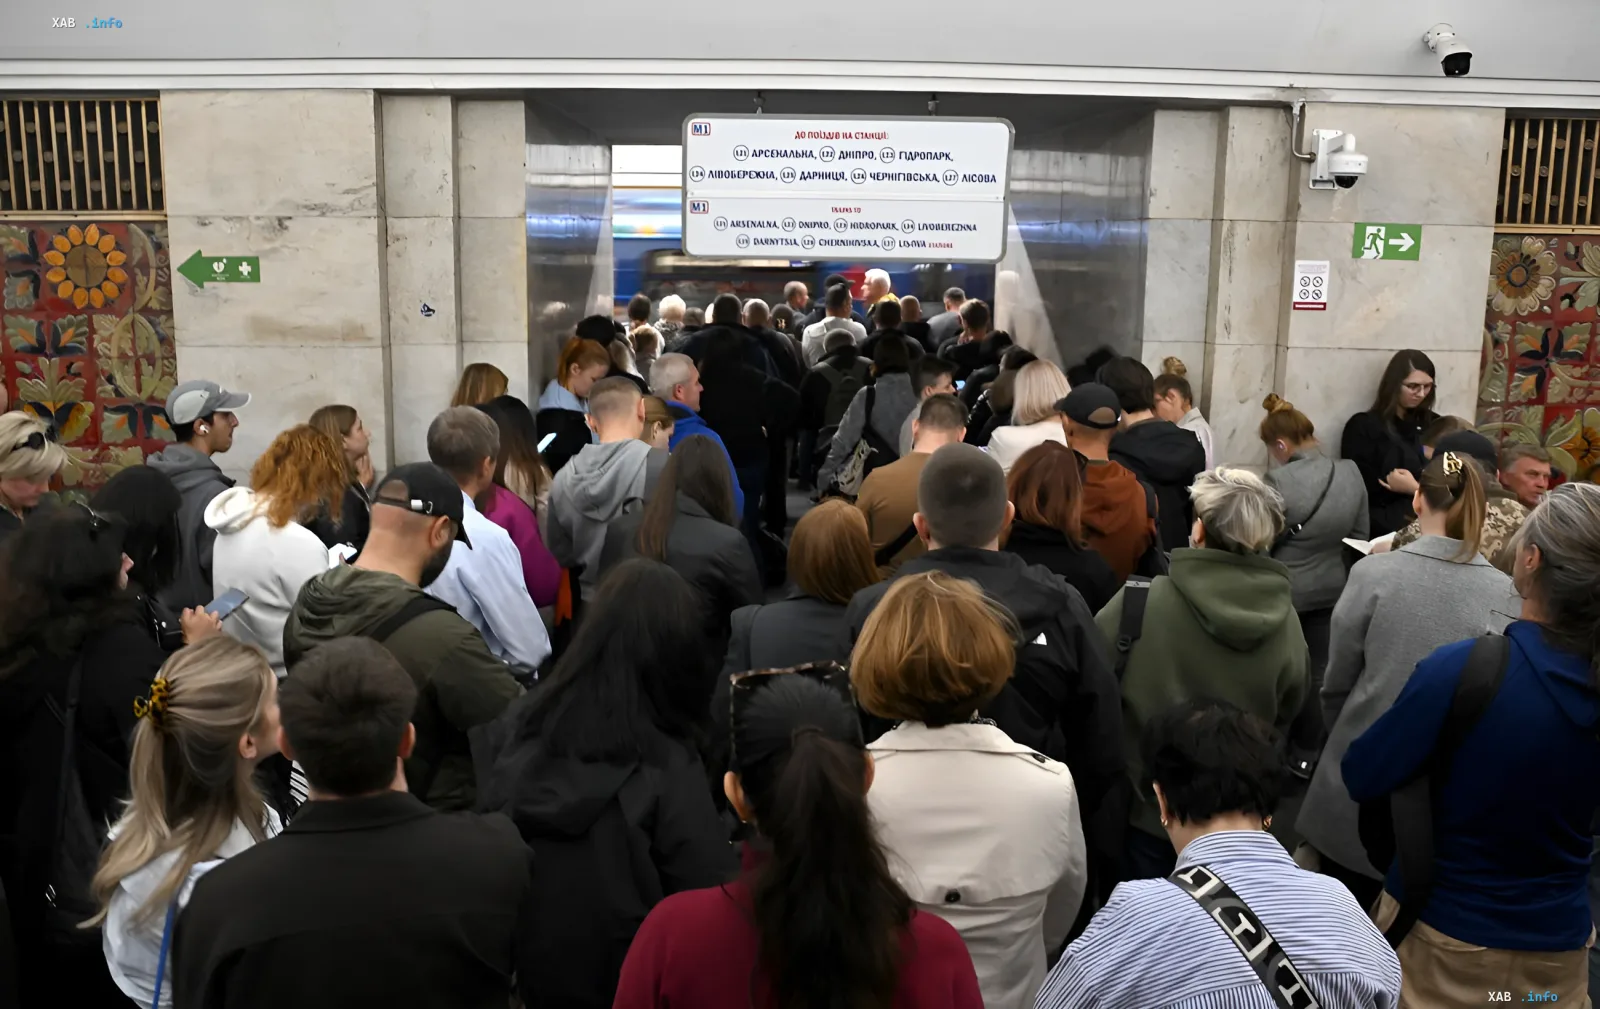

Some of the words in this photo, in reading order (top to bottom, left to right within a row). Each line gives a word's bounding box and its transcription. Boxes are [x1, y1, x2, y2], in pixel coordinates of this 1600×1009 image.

[838, 150, 877, 161] ДНІПРО,
[899, 151, 954, 162] ГІДРОПАРК,
[961, 173, 997, 183] ЛІСОВА
